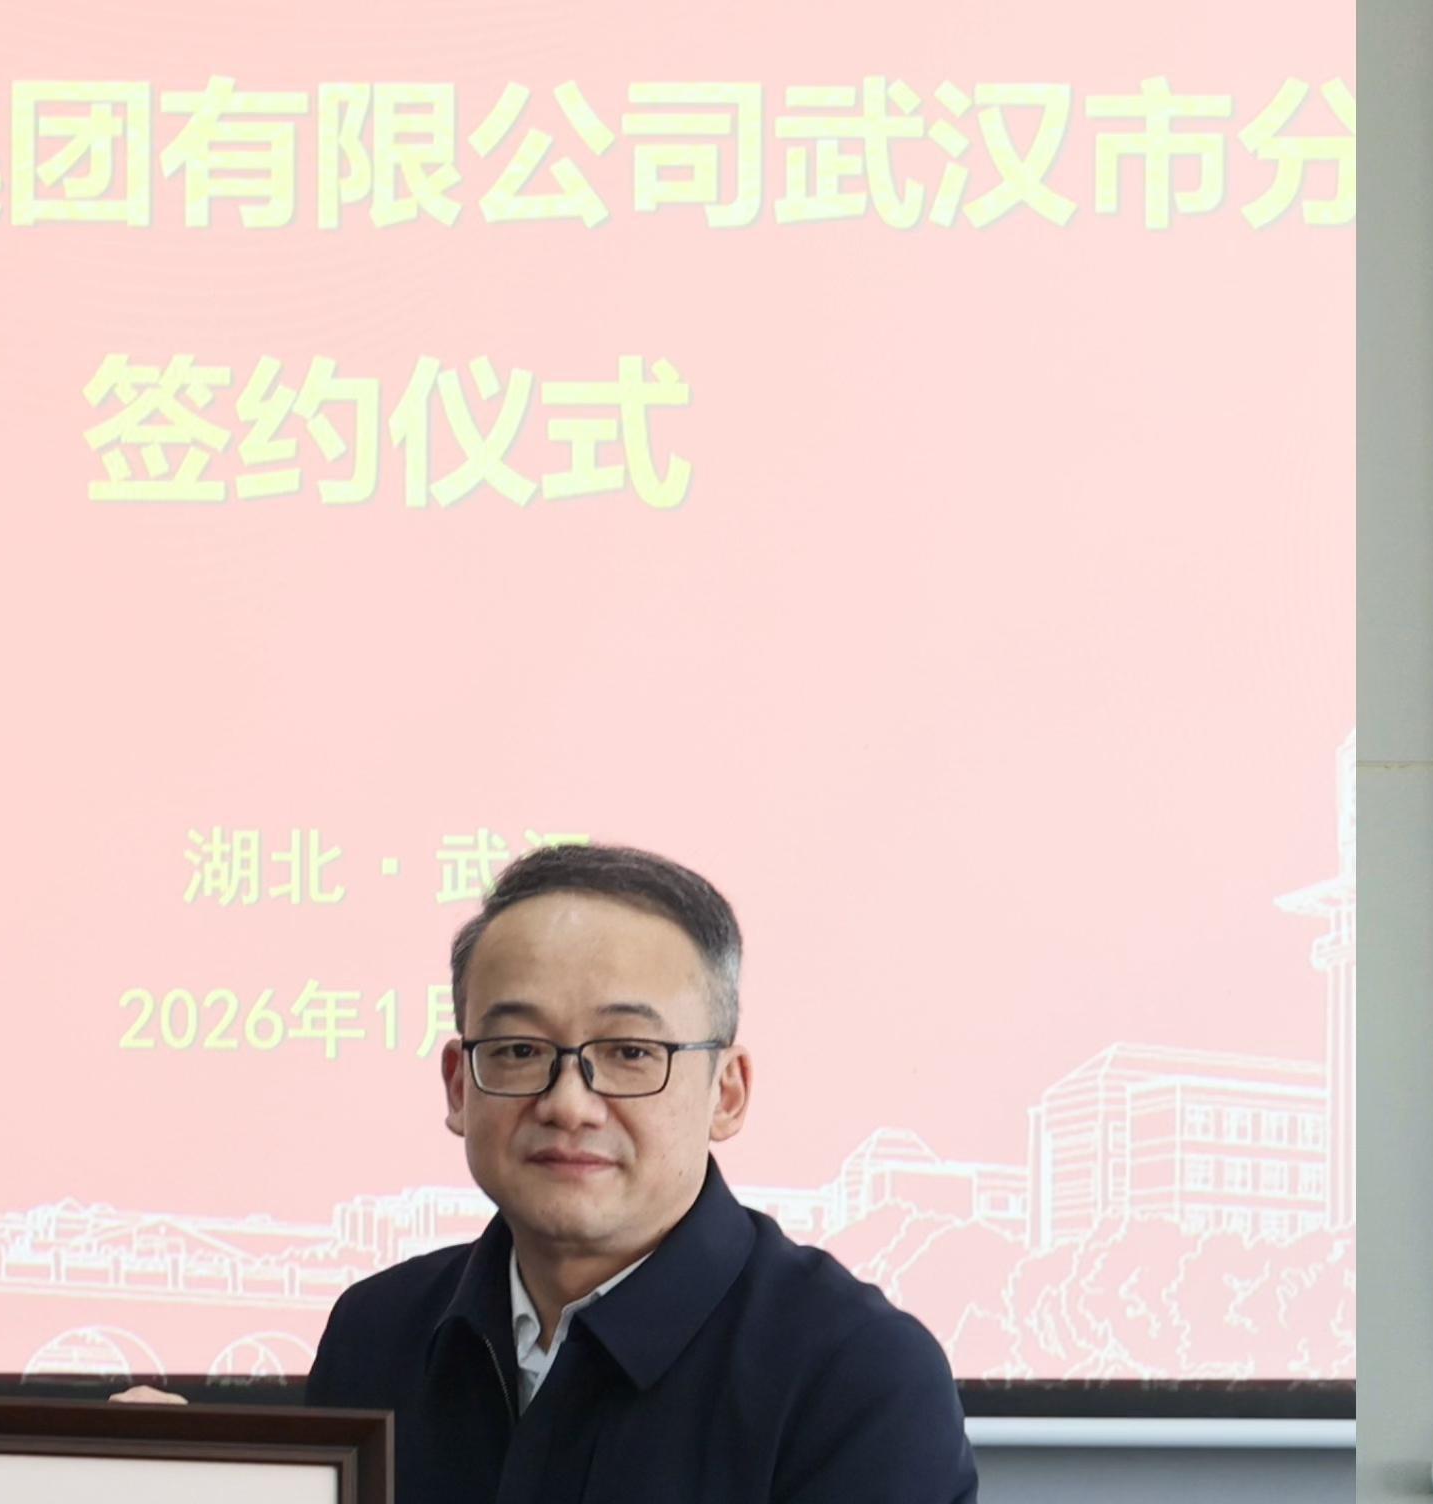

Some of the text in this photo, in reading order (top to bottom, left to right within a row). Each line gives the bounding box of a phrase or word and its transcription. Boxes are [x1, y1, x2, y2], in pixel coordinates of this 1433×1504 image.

[82, 352, 692, 509] 签约仪式
[182, 828, 591, 905] 湖北·武
